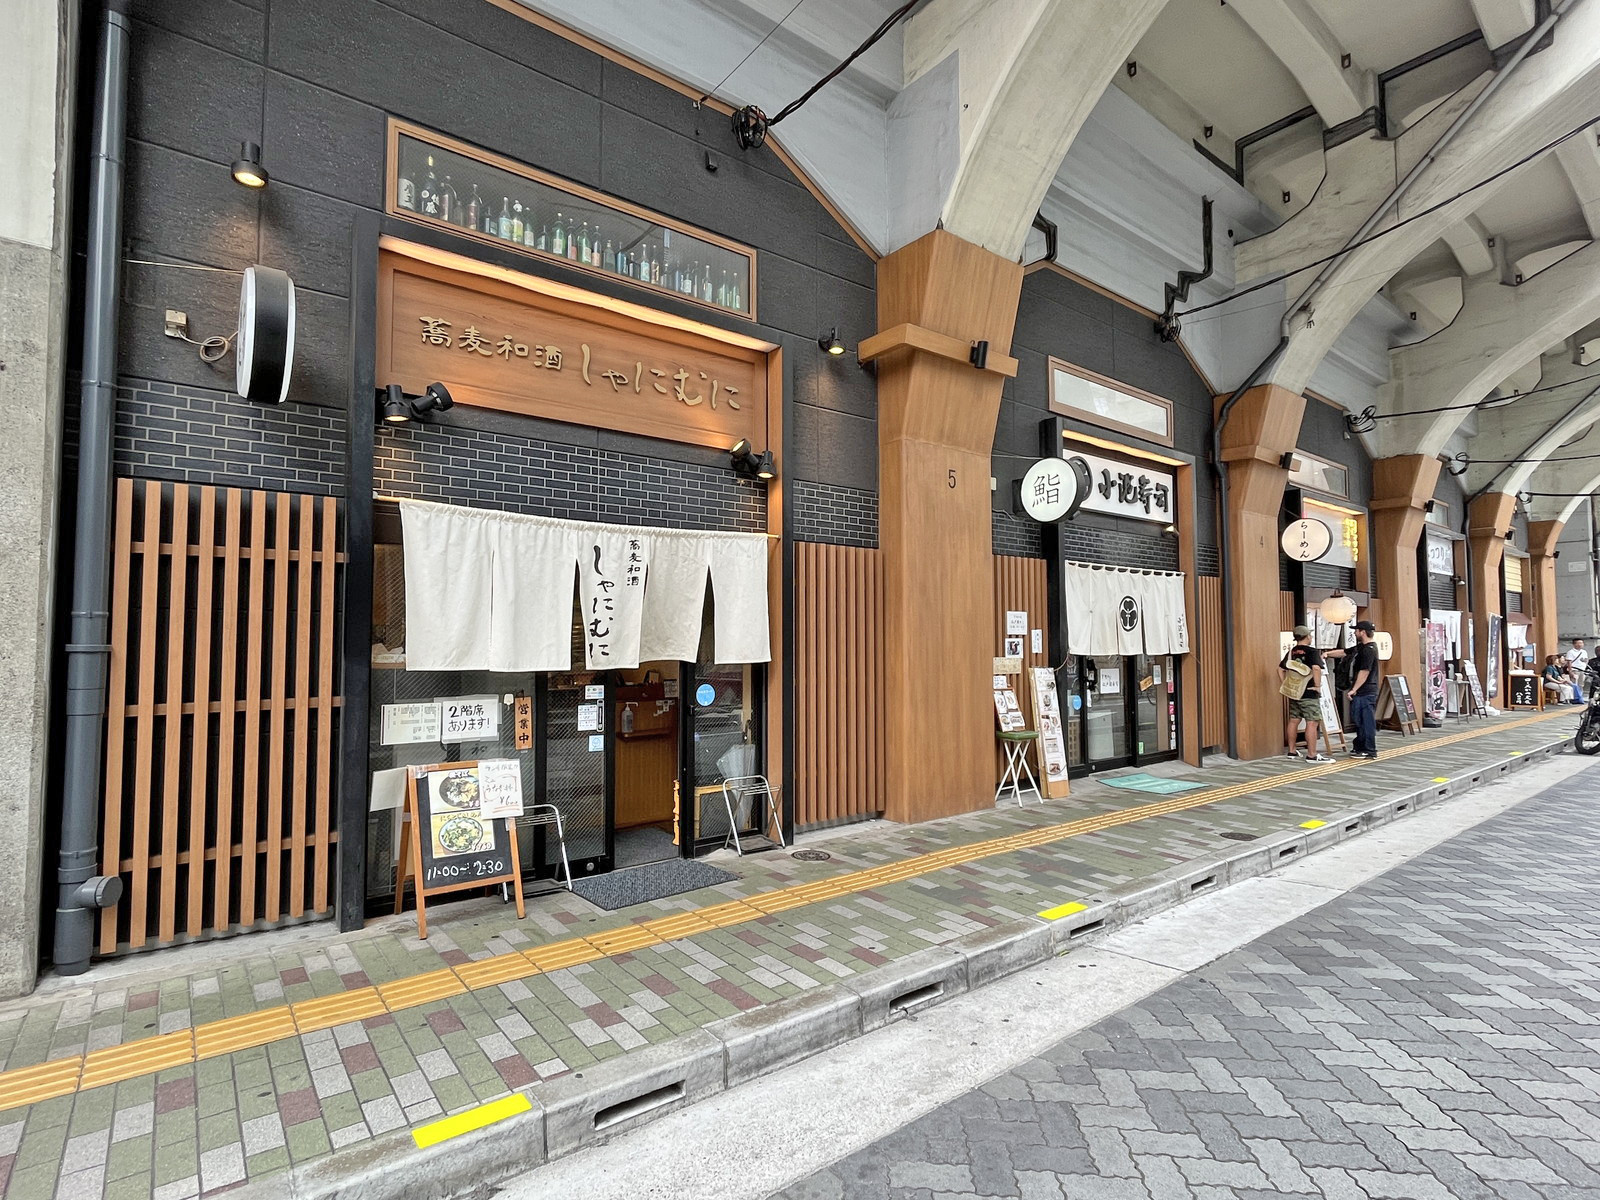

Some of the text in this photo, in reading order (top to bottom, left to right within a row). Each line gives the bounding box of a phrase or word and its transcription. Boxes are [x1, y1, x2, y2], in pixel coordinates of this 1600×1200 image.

[419, 316, 741, 411] 蕎麦和酒 しゃにむに
[947, 469, 957, 489] 5
[1032, 473, 1061, 507] 鮨
[1299, 521, 1310, 559] らーめん
[627, 539, 642, 587] 蕎麦和酒
[588, 545, 615, 660] しゃにむに
[448, 703, 484, 719] 2階席
[517, 703, 531, 745] 営業中
